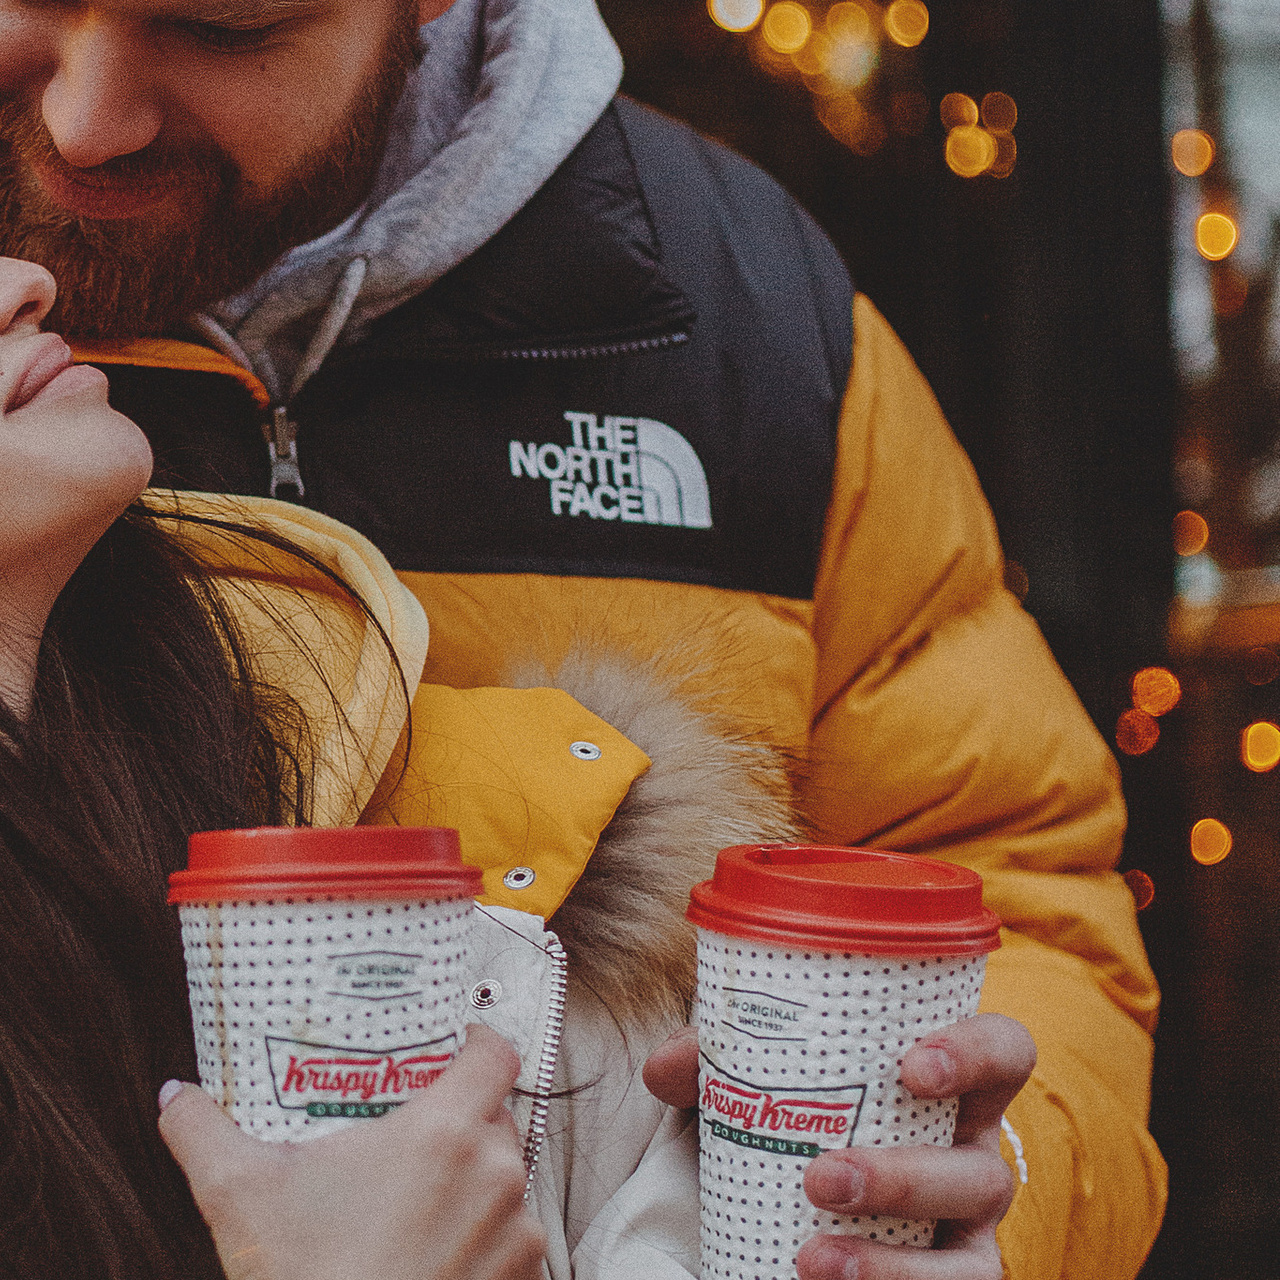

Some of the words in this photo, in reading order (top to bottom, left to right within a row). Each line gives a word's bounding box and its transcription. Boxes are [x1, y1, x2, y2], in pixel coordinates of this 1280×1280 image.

[564, 411, 637, 452] THE
[509, 440, 640, 488] NORTH
[550, 479, 644, 522] FACE
[738, 1015, 762, 1029] SINCE
[764, 1022, 784, 1032] 1937
[741, 1002, 800, 1022] ORIGINAL
[282, 1055, 382, 1100] Krispy
[380, 1054, 451, 1094] Krem
[702, 1075, 762, 1130] Krispy
[758, 1094, 854, 1135] Kreme
[714, 1125, 811, 1155] DOUGHNUTS
